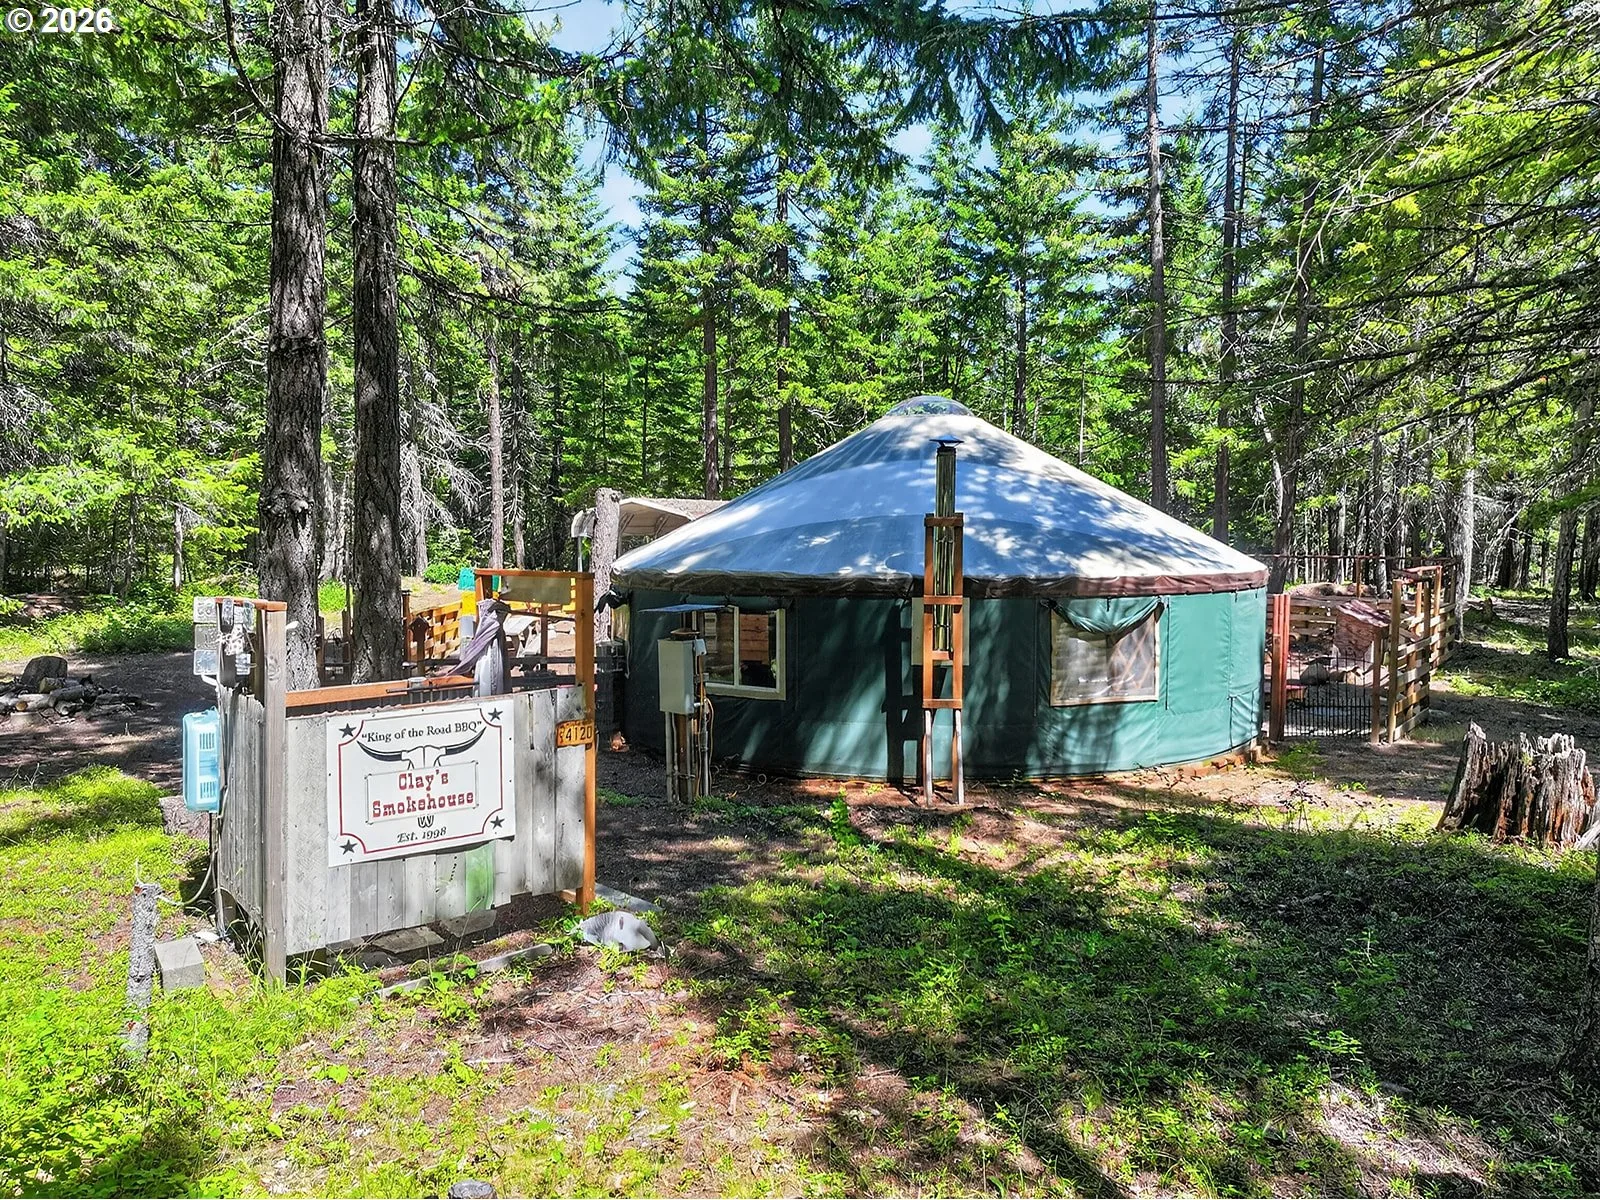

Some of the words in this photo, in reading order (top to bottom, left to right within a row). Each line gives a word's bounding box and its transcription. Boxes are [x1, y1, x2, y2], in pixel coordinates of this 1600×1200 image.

[394, 728, 406, 739] of
[408, 727, 424, 738] the
[427, 724, 452, 735] Road
[398, 769, 449, 791] Clay's
[372, 792, 474, 818] Smokehouse
[397, 831, 418, 844] Est.
[422, 826, 447, 840] 1998
